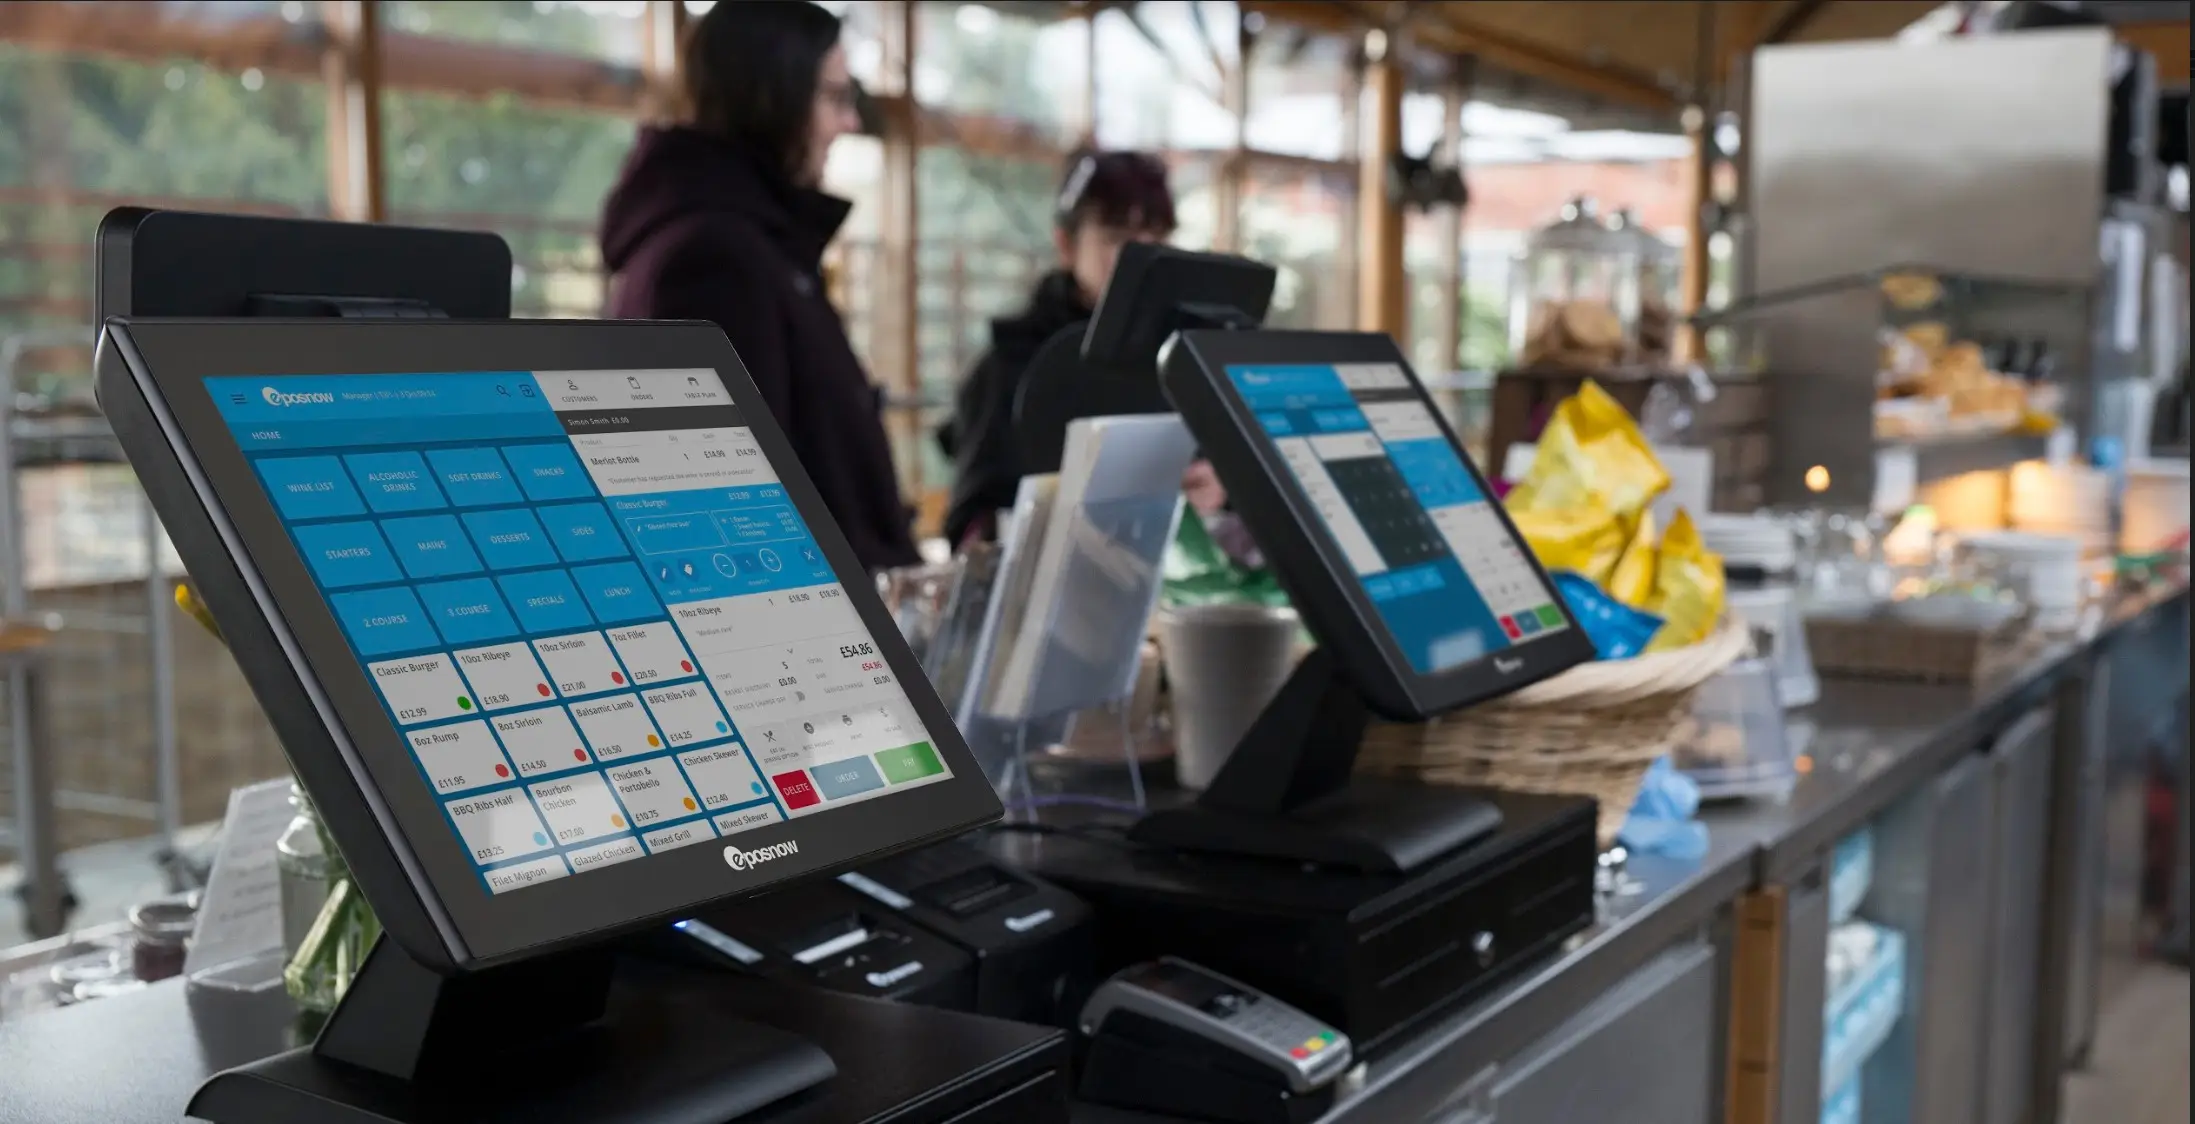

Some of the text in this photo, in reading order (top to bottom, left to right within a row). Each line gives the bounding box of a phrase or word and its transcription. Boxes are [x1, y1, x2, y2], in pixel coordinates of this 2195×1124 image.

[262, 386, 334, 407] eposnow
[562, 395, 598, 403] CUSTOMERS
[631, 393, 653, 401] ORDERS
[568, 418, 589, 426] Simon
[590, 417, 610, 425] Smith
[252, 430, 281, 441] HOME
[617, 455, 640, 464] Bottle
[683, 453, 689, 461] 1
[703, 449, 726, 459] £14.99
[368, 470, 419, 481] ALCOHOLIC
[448, 471, 502, 483] SOFT DRINKS
[533, 467, 565, 477] SNACKS
[287, 481, 334, 493] WINE LIST
[383, 482, 416, 493] DRINKS
[616, 500, 642, 510] Classic
[571, 526, 595, 536] SIDES
[490, 532, 530, 544] DESSERTS
[417, 540, 447, 551] MAINS
[326, 547, 371, 560] STARTERS
[604, 587, 631, 598] LUNCH
[527, 595, 565, 607] SPECIALS
[678, 589, 840, 619] 10oz Ribeye 1 £18.90 £18.90
[447, 604, 491, 618] 3 COURSE
[363, 614, 409, 628] 2 COURSE
[612, 629, 647, 642] 7oz Fillet
[539, 639, 586, 653] 10oz Sirloin
[840, 642, 874, 659] £54.86
[460, 650, 511, 666] 10oz Ribeye
[376, 661, 440, 677] Classic Burger
[782, 661, 789, 670] 5
[862, 661, 883, 671] £54.86
[634, 669, 658, 681] £20.50
[778, 676, 797, 687] £0.00
[561, 680, 586, 692] £21.00
[823, 685, 844, 694] SERVICE
[874, 675, 891, 685] £0.00
[483, 693, 510, 705] £18.90
[648, 688, 697, 705] BBQ Ribs Full
[399, 707, 428, 720] £12.99
[576, 700, 634, 718] Balsamic Lamb
[733, 702, 754, 712] SERVICE
[497, 716, 543, 731] 8oz Sirloin
[414, 731, 460, 747] 8oz Rump
[670, 730, 693, 742] £14.25
[598, 745, 622, 757] £16.50
[683, 748, 739, 767] Chicken Skewer
[521, 759, 547, 772] £14.50
[902, 757, 915, 768] PAY
[612, 766, 652, 782] Chicken &
[835, 771, 860, 784] ORDER
[437, 775, 466, 789] £11.95
[619, 779, 660, 794] Portobello
[535, 784, 573, 798] Bourbon
[782, 782, 810, 796] DELETE
[452, 795, 514, 816] BBQ Ribs Half
[542, 797, 577, 812] Chicken
[706, 793, 729, 805] £12.40
[635, 810, 659, 823] £10.75
[719, 811, 769, 830] Mixed Skewer
[559, 827, 585, 840] £17.00
[649, 830, 692, 847] Mixed Grill
[477, 846, 505, 859] £13.25
[574, 845, 636, 867] Glazed Chicken
[723, 839, 799, 871] eposnow
[492, 867, 547, 887] Filet Mignon
